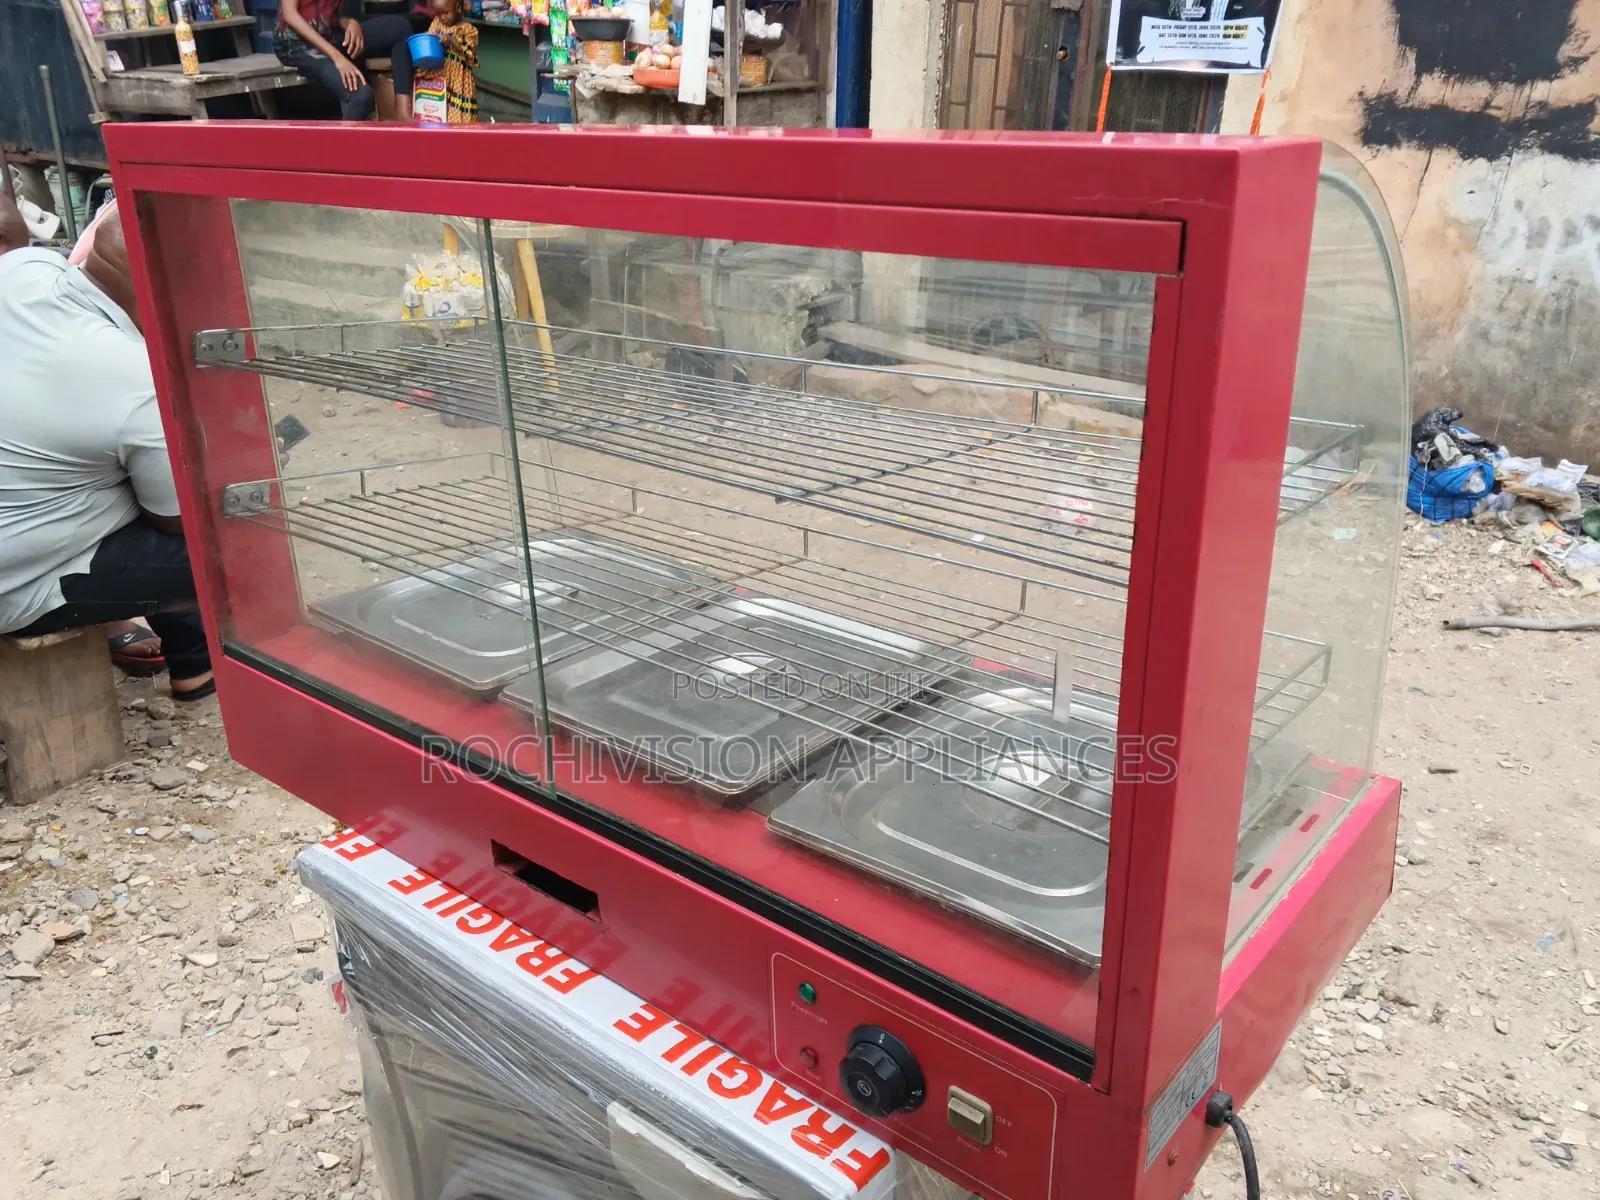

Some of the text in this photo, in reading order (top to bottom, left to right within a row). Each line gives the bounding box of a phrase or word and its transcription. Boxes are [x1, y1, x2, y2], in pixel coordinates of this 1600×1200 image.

[388, 866, 600, 994] FRAGILE
[613, 1002, 891, 1192] FRAGILE
[995, 1115, 1014, 1128] OFF
[957, 1135, 981, 1154] Power
[994, 1146, 1009, 1158] ON
